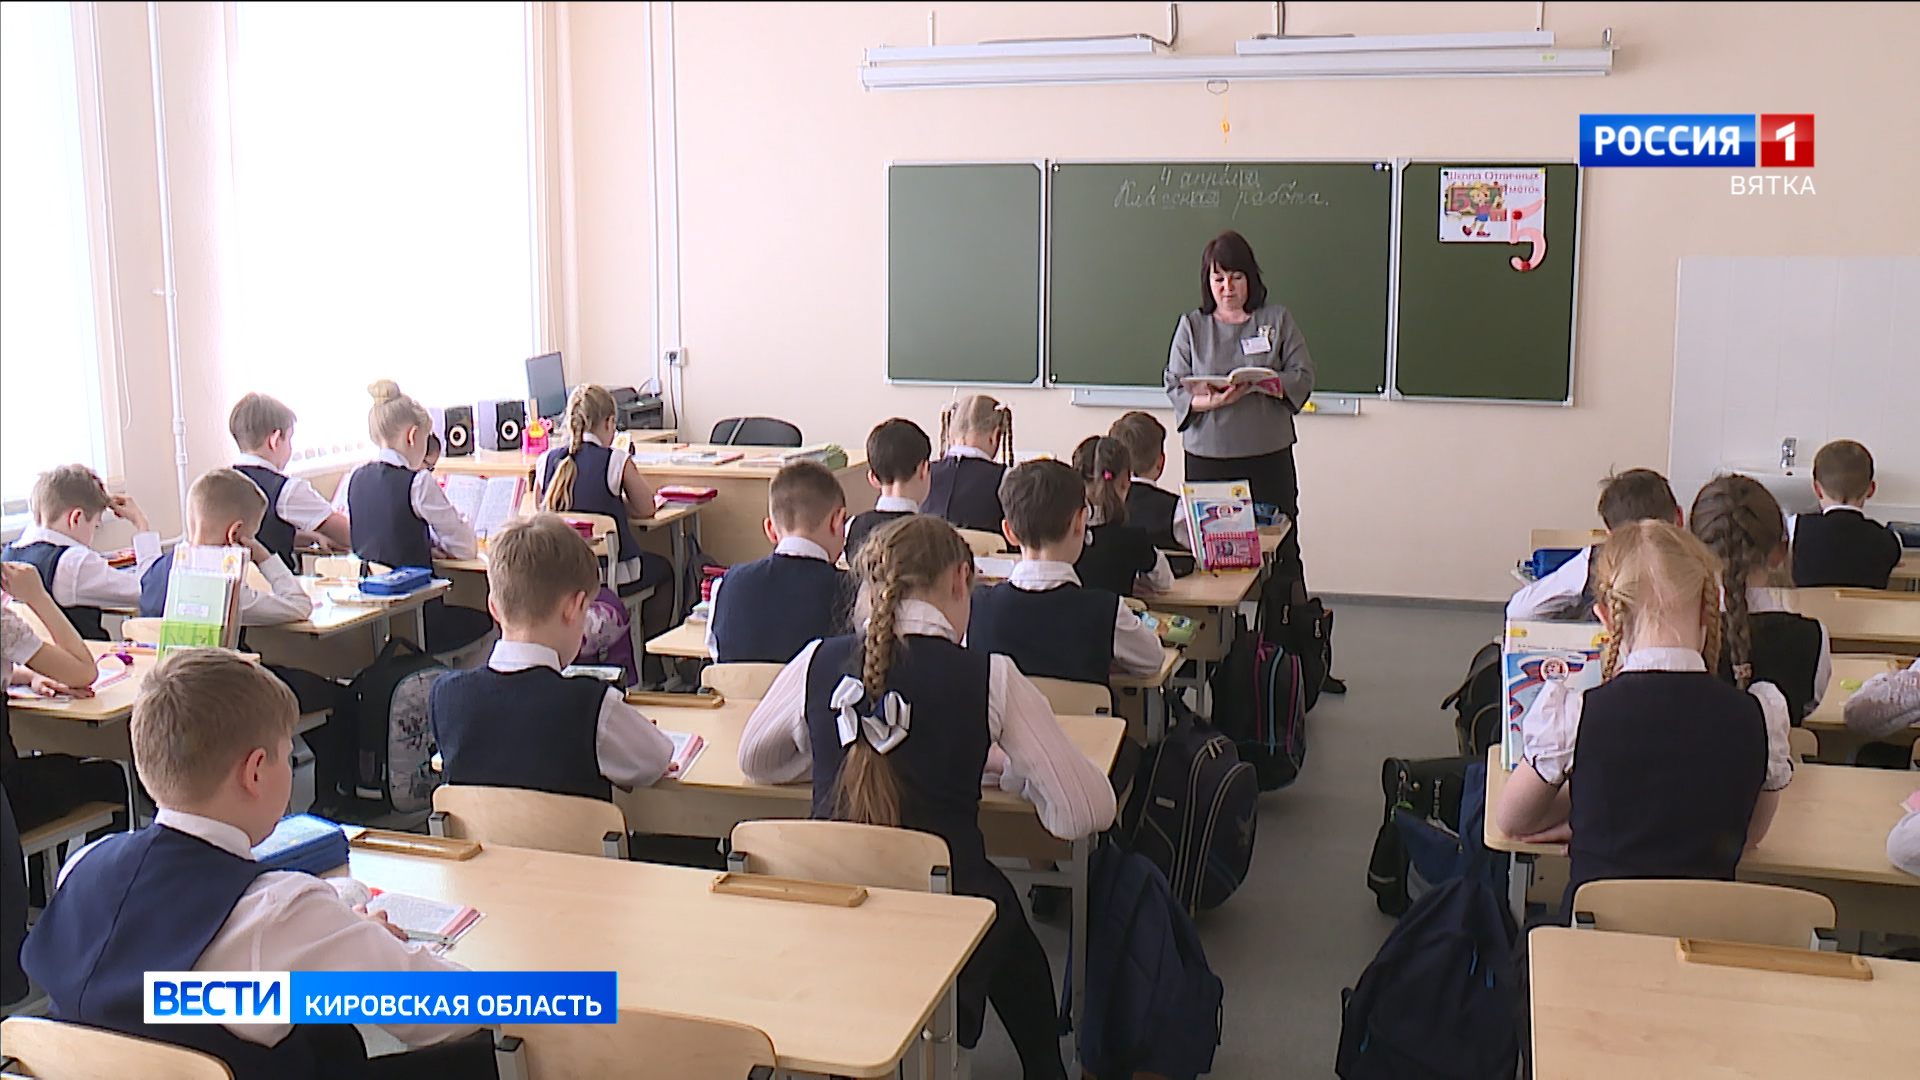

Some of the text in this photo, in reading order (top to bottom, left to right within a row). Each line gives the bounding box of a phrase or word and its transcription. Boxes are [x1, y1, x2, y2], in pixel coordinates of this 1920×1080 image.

[1160, 163, 1261, 190] 4 апреля
[1113, 178, 1220, 209] Классная
[1509, 198, 1547, 271] 5
